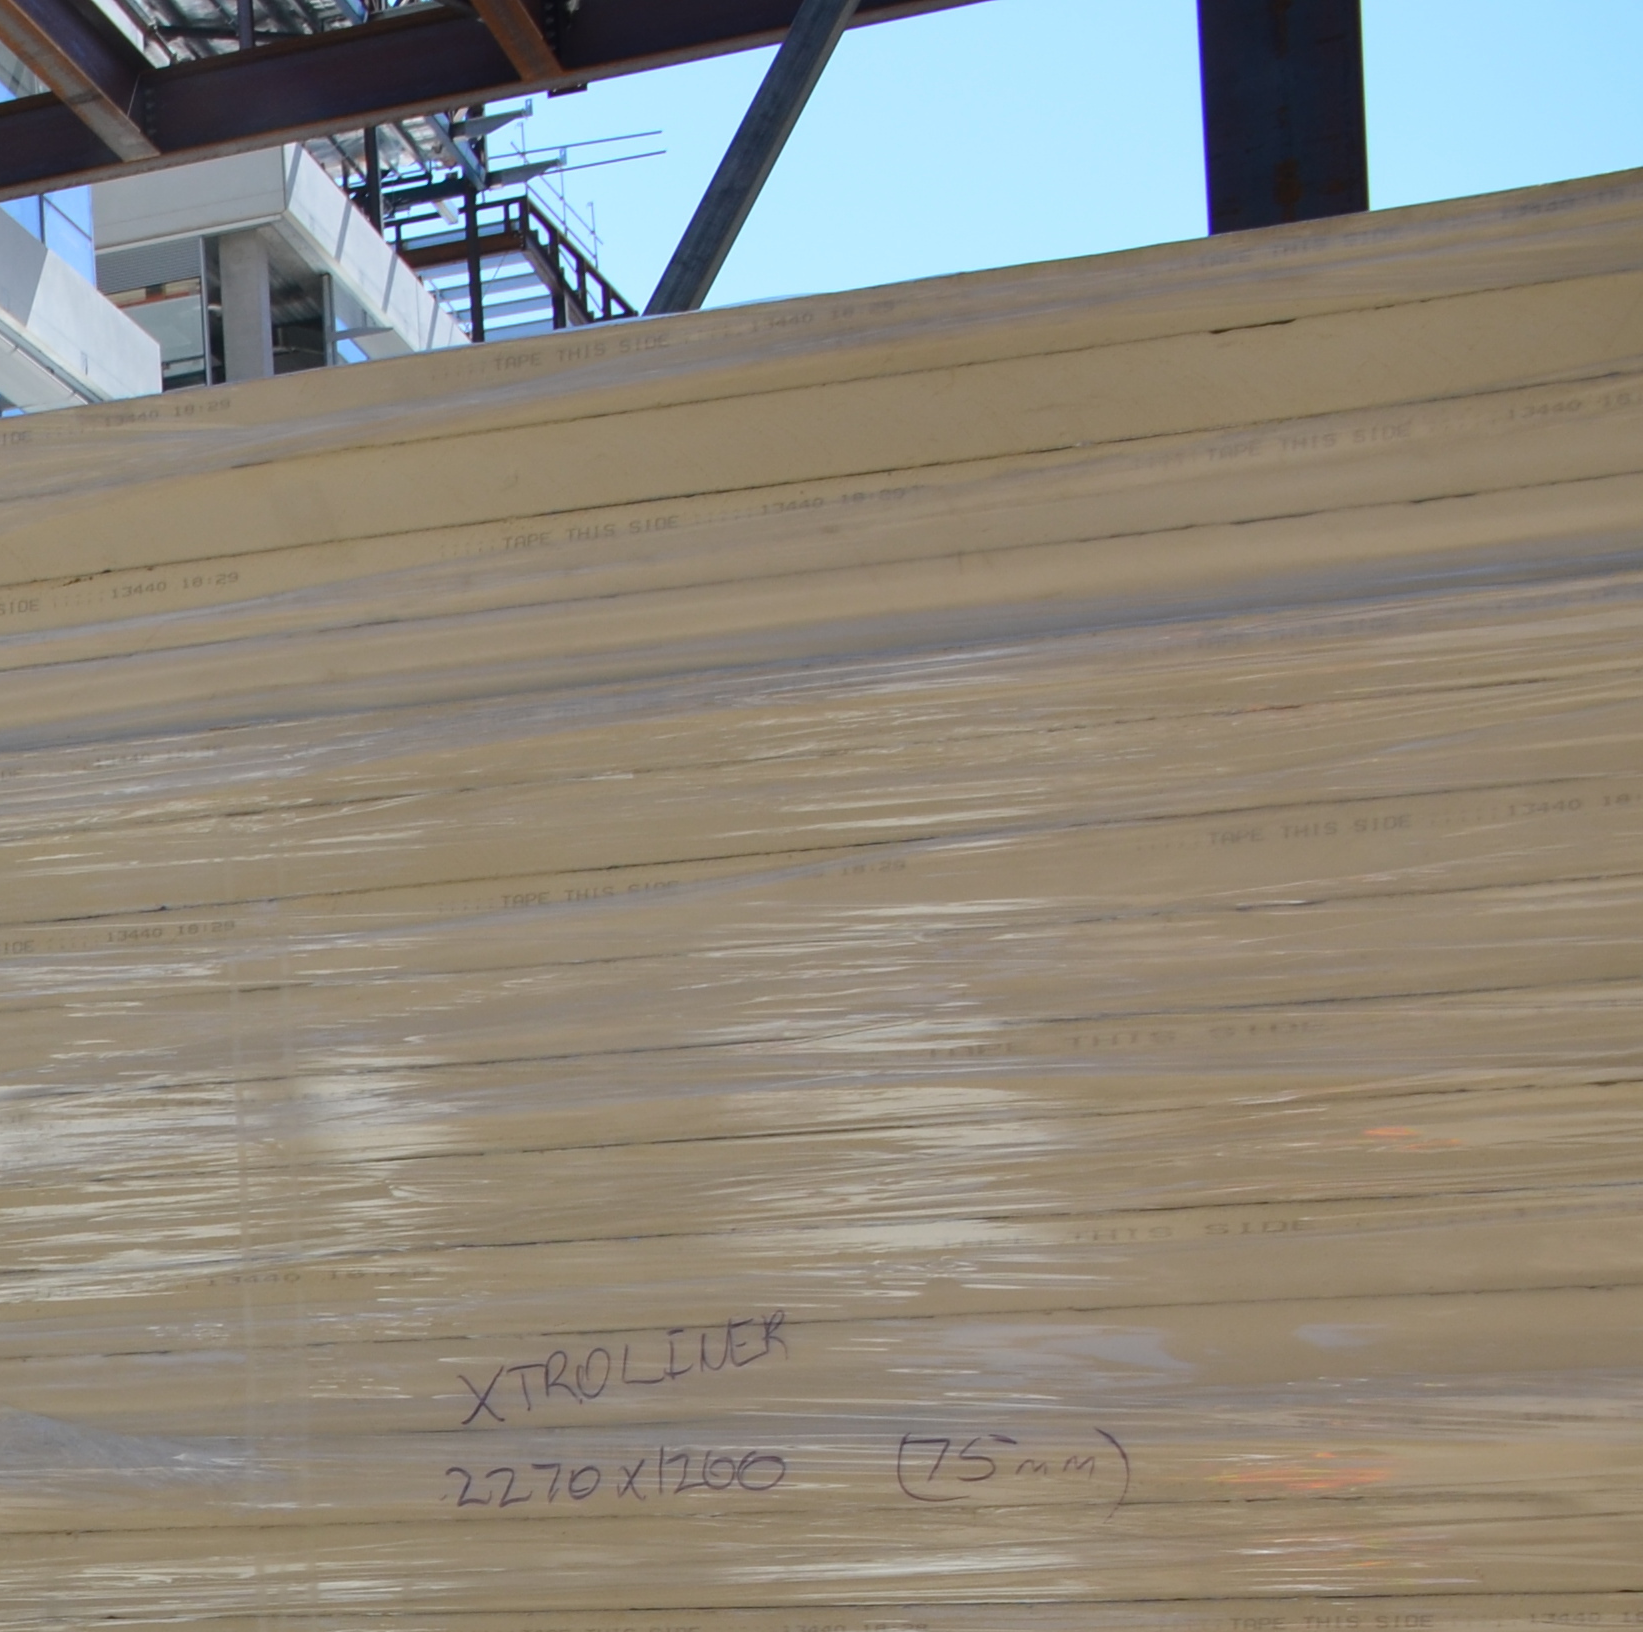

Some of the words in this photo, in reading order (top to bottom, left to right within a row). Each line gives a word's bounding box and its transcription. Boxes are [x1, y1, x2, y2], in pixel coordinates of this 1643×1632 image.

[496, 351, 543, 369] TAPE
[558, 344, 605, 362] THIS
[619, 335, 671, 354] SIDE
[1207, 443, 1261, 461] TAPE
[1279, 432, 1336, 452] THIS
[1354, 422, 1413, 443] SIDE
[503, 530, 552, 550] TAPE
[566, 522, 615, 542] THIS
[628, 514, 679, 535] SIDE
[111, 579, 168, 600] 13440
[182, 571, 239, 590] 18:29
[1208, 828, 1264, 848] TAPE
[1281, 821, 1337, 840] THIS
[1355, 814, 1412, 833] SIDE
[1508, 796, 1583, 818] 13440
[501, 890, 550, 909] TAPE
[564, 884, 615, 903] THIS
[107, 927, 163, 943] 13440
[176, 920, 235, 936] 18:29
[460, 1309, 790, 1425] XTROLINER
[1229, 1615, 1283, 1631] TAPE
[1303, 1614, 1357, 1629] THIS
[1376, 1613, 1436, 1628] SIDE
